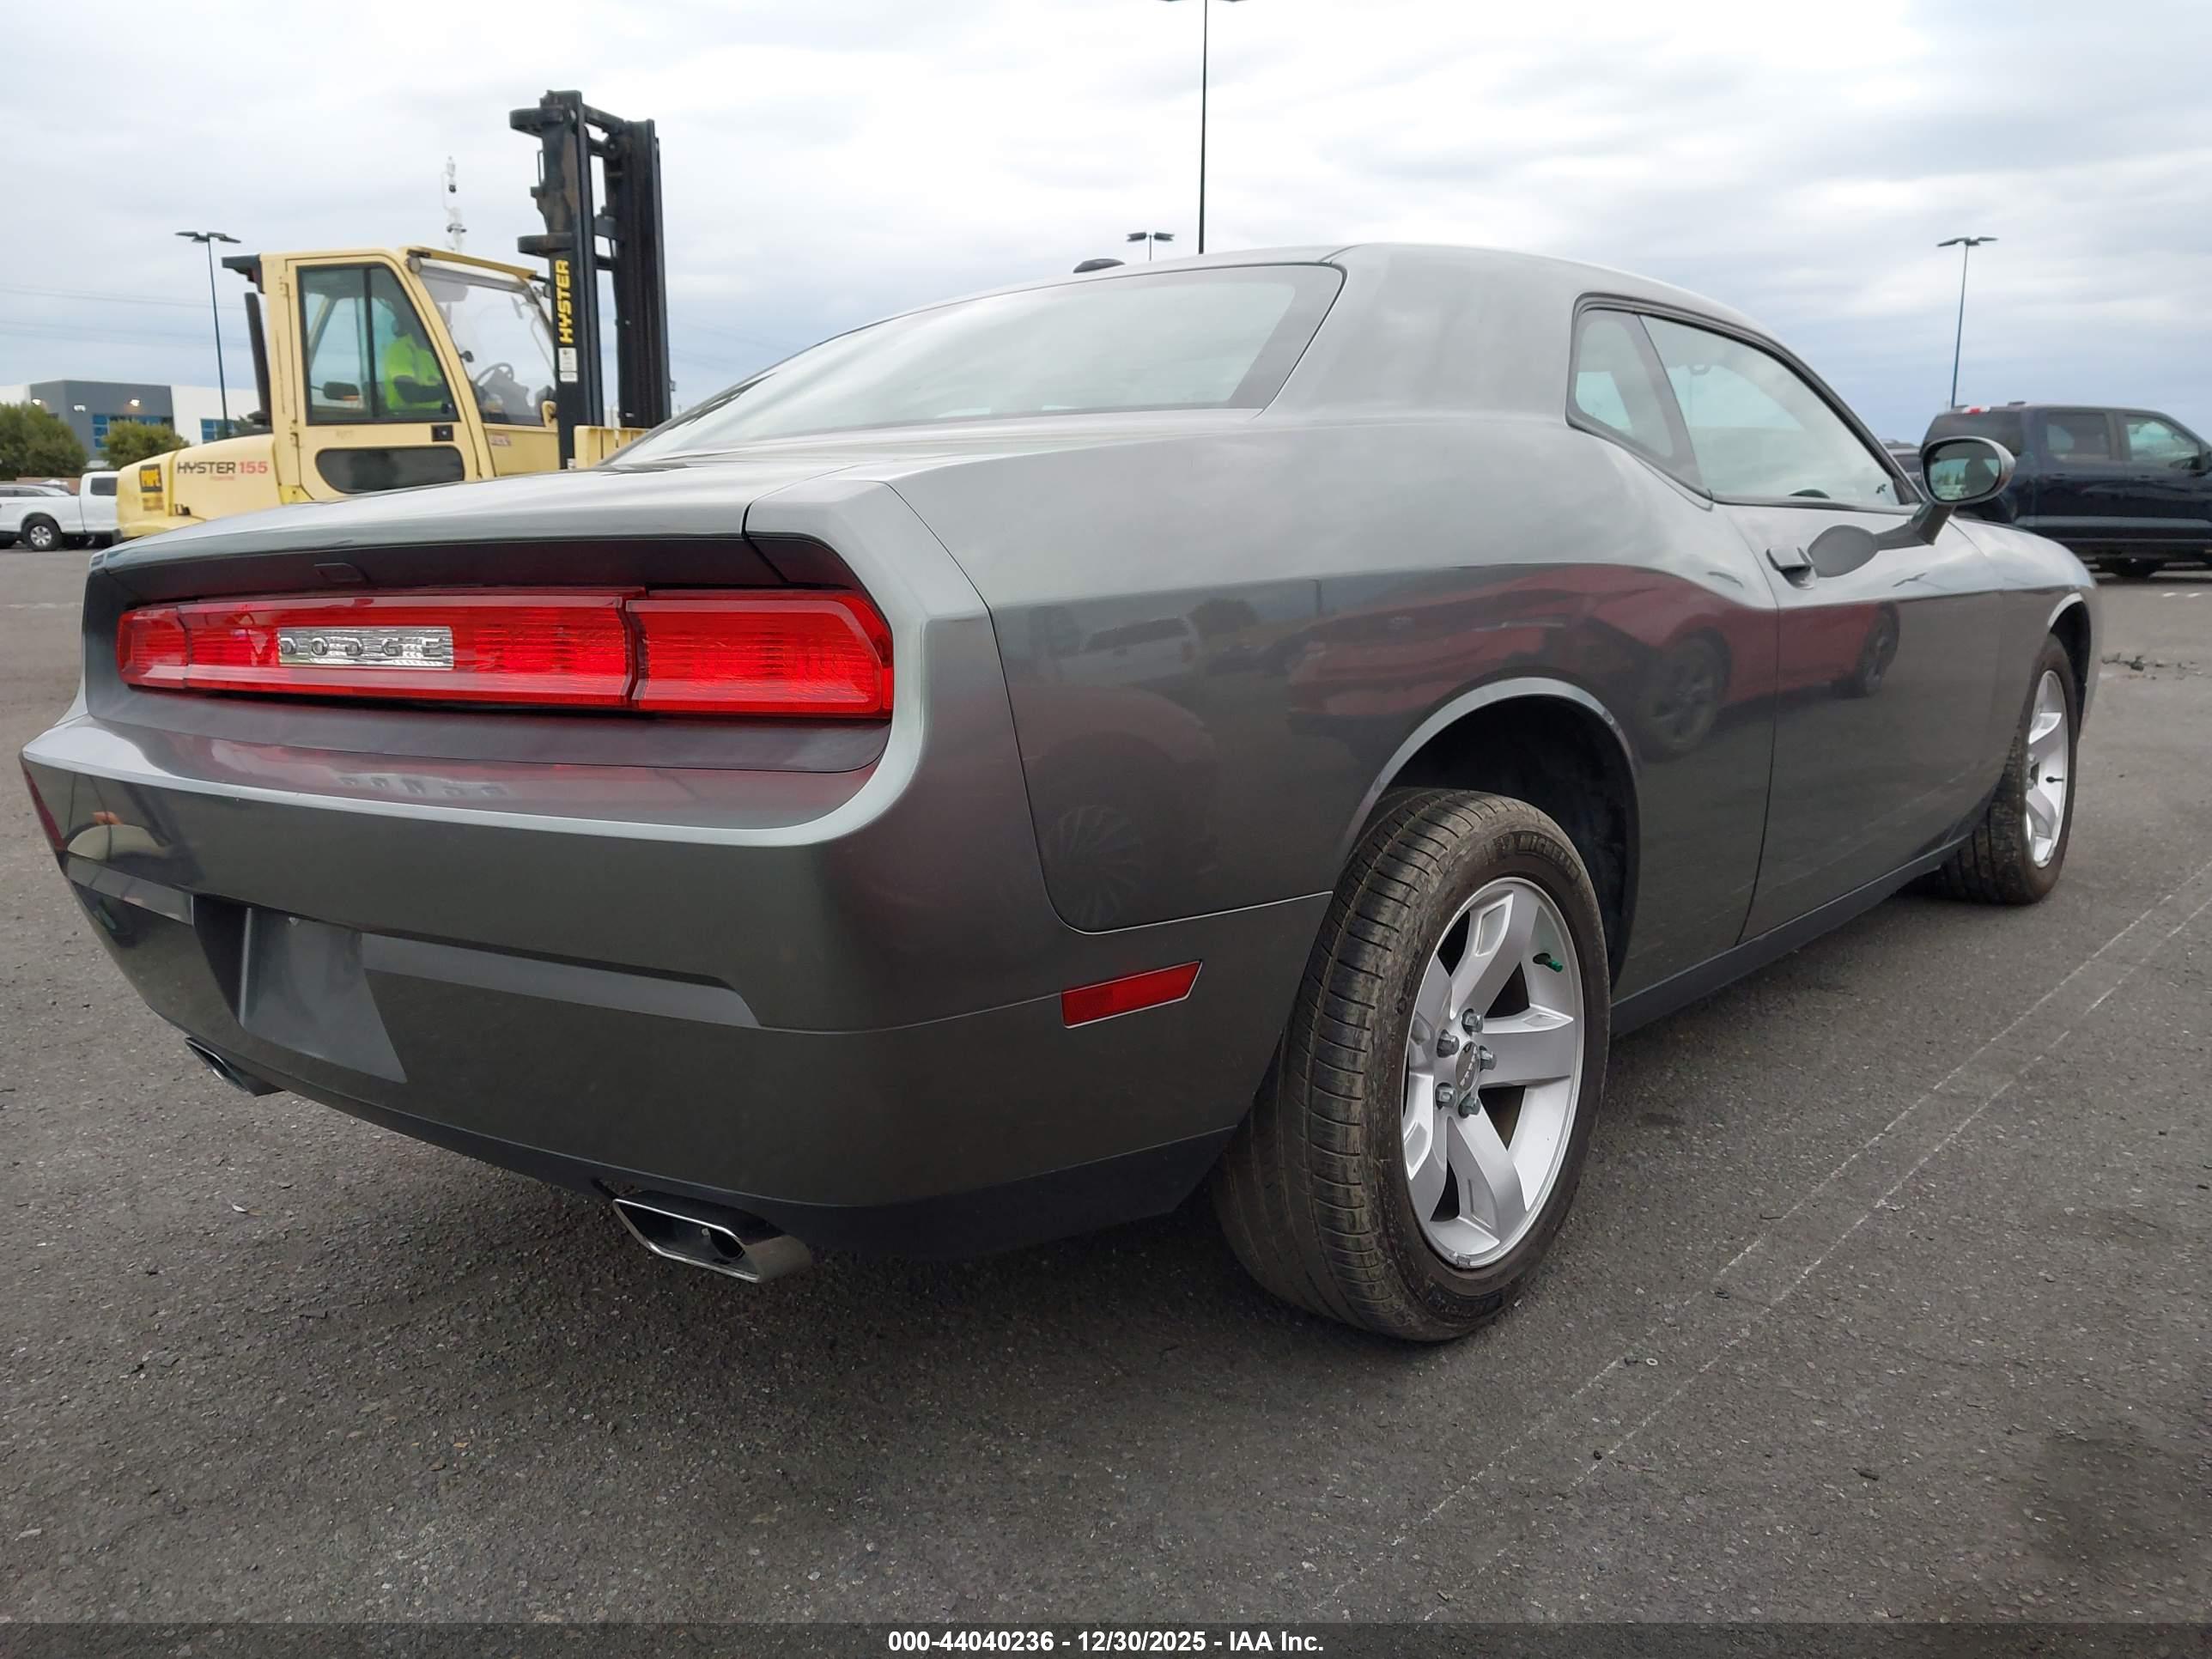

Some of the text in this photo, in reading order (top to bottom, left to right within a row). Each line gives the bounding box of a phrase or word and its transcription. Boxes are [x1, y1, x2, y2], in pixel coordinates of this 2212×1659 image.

[556, 260, 574, 343] HYSTER
[177, 461, 268, 473] HYSTER 155
[280, 637, 442, 657] DODGE
